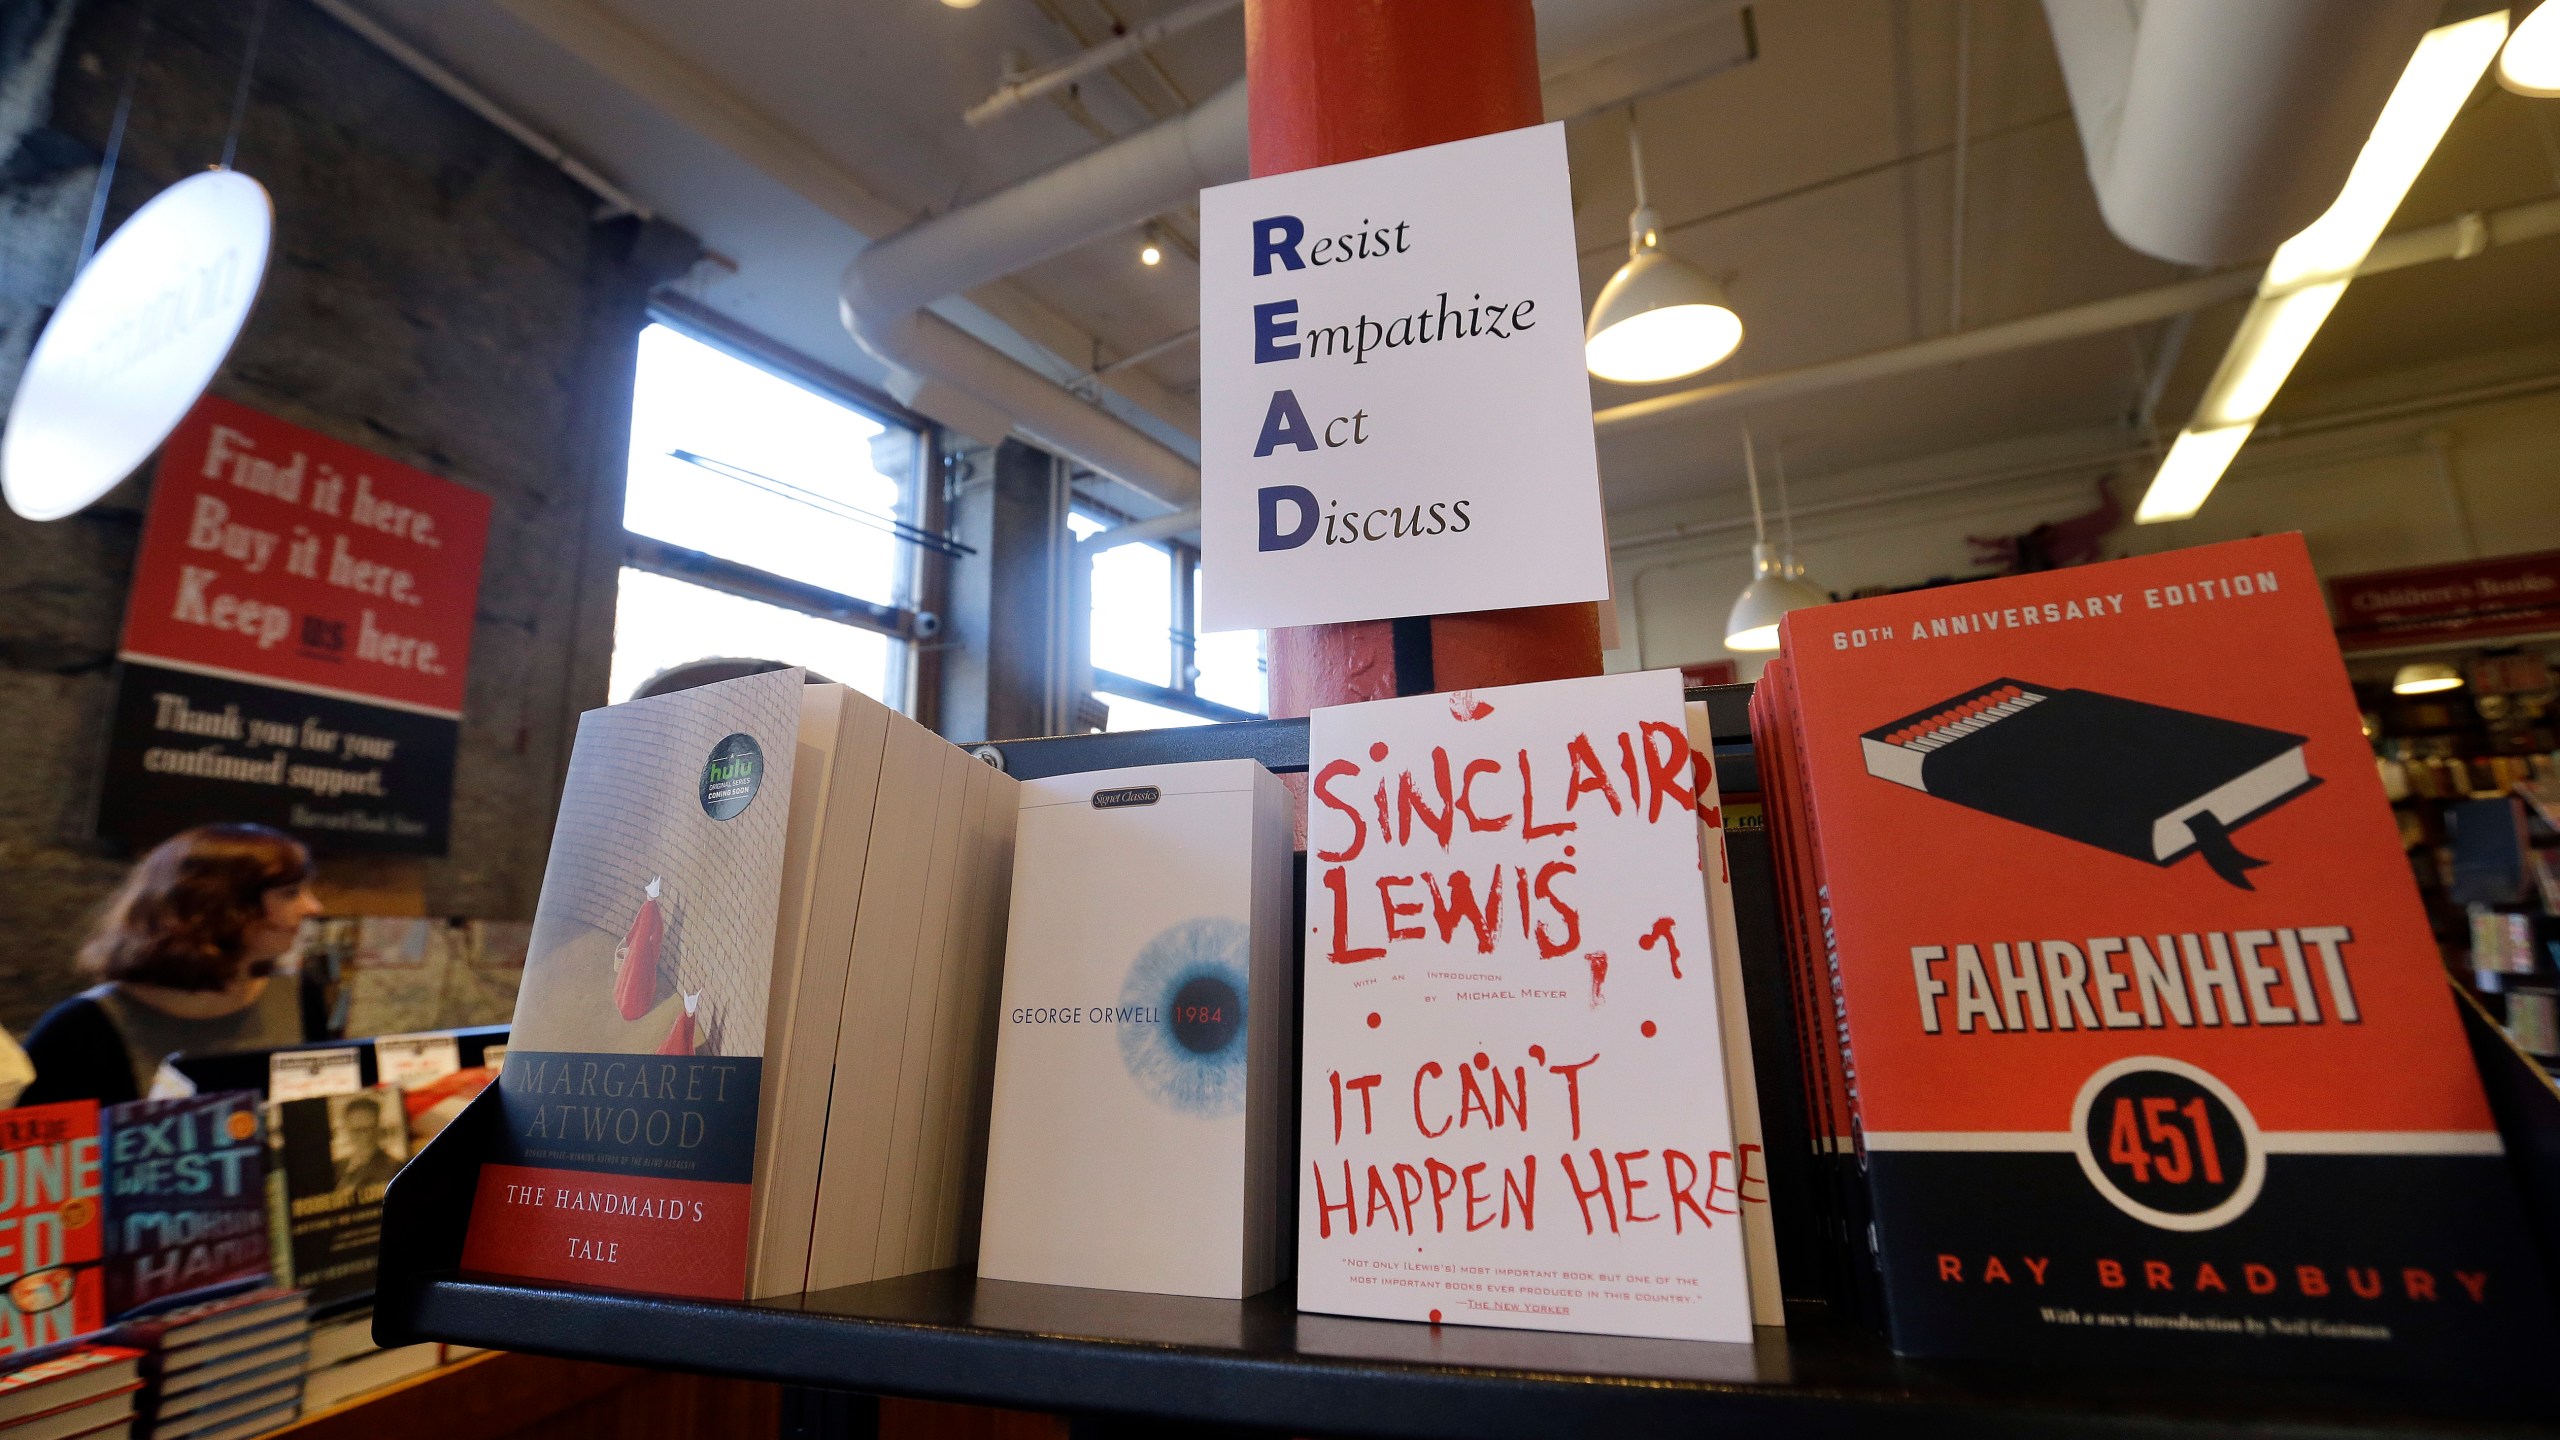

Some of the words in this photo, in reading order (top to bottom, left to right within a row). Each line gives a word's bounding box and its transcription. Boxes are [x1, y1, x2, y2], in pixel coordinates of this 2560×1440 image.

[1252, 214, 1411, 277] Resist
[1253, 292, 1537, 365] Empathize
[1252, 389, 1369, 457] Act
[204, 425, 307, 503] Find
[311, 463, 345, 516] it
[352, 474, 442, 548] here.
[1257, 485, 1471, 553] Discuss
[187, 493, 279, 573] Buy
[287, 527, 320, 578] it
[328, 535, 422, 607] here.
[173, 565, 290, 649] Keep
[357, 609, 447, 676] here.
[1833, 625, 1894, 651] 60TH
[1912, 594, 2126, 641] ANNIVERSARY
[2144, 571, 2279, 609] EDITION
[154, 692, 244, 740] Thank
[245, 719, 298, 748] you
[300, 716, 339, 752] for
[340, 734, 395, 761] your
[144, 744, 287, 785] continued
[287, 763, 388, 797] support.
[708, 780, 731, 791] ORIGINAL
[732, 777, 751, 787] SERIES
[708, 790, 731, 799] COMING
[732, 786, 750, 796] SOON
[710, 759, 752, 782] hulu
[1094, 793, 1120, 807] Signet
[1121, 790, 1158, 802] Classics
[1323, 861, 1582, 965] LEWIS
[1353, 978, 1377, 989] WITH
[1392, 974, 1405, 982] AN
[1427, 971, 1502, 982] INTRODUCTION
[1457, 991, 1516, 1001] MICHAEL
[1521, 989, 1567, 999] MEYER
[1911, 926, 2361, 1035] FAHRENHEIT
[1012, 1007, 1082, 1024] GEORGE
[1089, 1007, 1161, 1024] ORWELL
[1176, 1007, 1222, 1024] 1984
[518, 1060, 736, 1102] MARGARET
[1328, 1070, 1382, 1146] IT
[1414, 1044, 1600, 1141] CAN'T
[112, 1102, 241, 1163] EXIT
[524, 1105, 706, 1149] ATWOOD
[2109, 1097, 2224, 1185] 451
[112, 1146, 261, 1198] WEST
[1313, 1154, 1536, 1239] HAPPEN
[1561, 1148, 1738, 1237] HERE
[507, 1185, 545, 1207] THE
[555, 1189, 704, 1222] HANDMAID'S
[568, 1237, 619, 1263] TALE
[1373, 1261, 1399, 1270] ONLY
[1460, 1266, 1491, 1275] MOST
[1495, 1268, 1558, 1279] IMPORTANT
[1563, 1272, 1594, 1281] BOOK
[1600, 1274, 1621, 1282] BUT
[1627, 1275, 1651, 1284] ONE
[1656, 1277, 1671, 1285] OF
[1676, 1278, 1699, 1287] THE
[1350, 1276, 1377, 1284] MOST
[1381, 1278, 1441, 1289] IMPORTANT
[1445, 1282, 1483, 1292] BOOKS
[1488, 1285, 1515, 1293] EVER
[1520, 1287, 1583, 1298] PRODUCED
[1604, 1292, 1631, 1300] THIS
[1635, 1293, 1703, 1304] COUNTRY."
[1937, 1254, 2052, 1286] RAY
[2097, 1259, 2489, 1302] BRADBURY
[1494, 1301, 1520, 1311] NEW
[1525, 1303, 1570, 1315] YORKER
[2040, 1305, 2080, 1325] With
[2082, 1313, 2094, 1326] a
[2097, 1312, 2129, 1327] new
[2133, 1310, 2242, 1333] introduction
